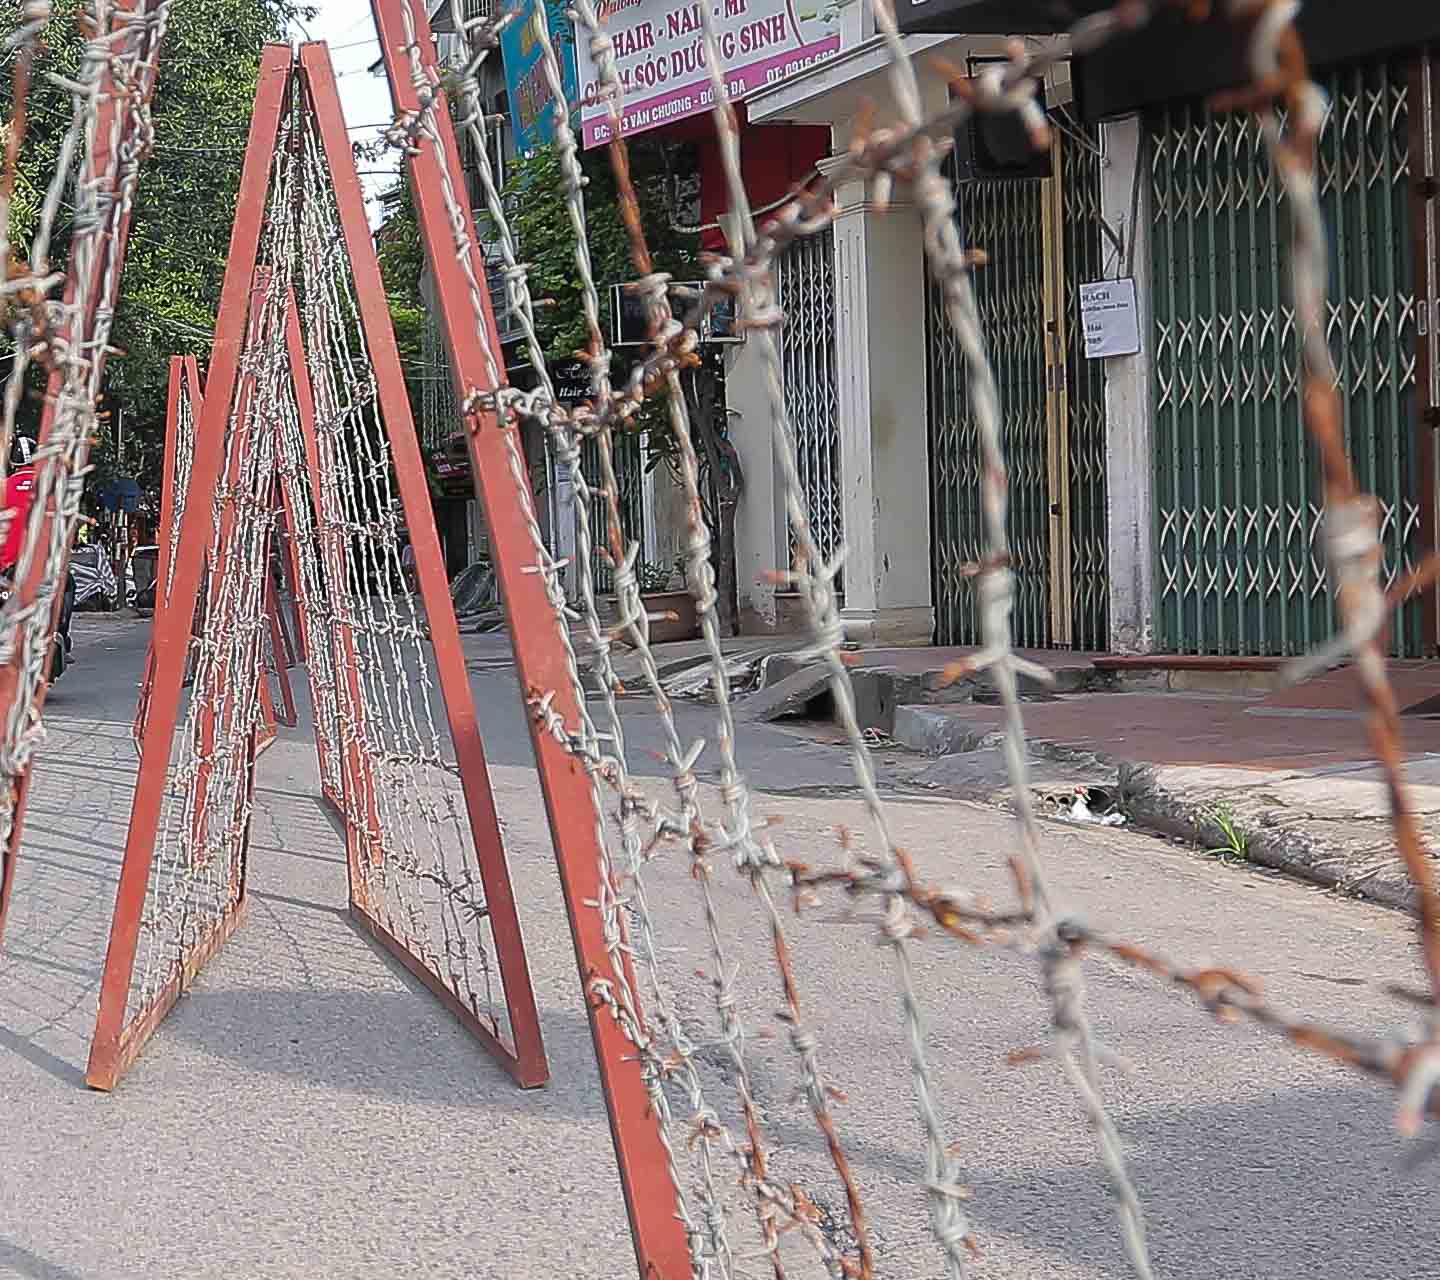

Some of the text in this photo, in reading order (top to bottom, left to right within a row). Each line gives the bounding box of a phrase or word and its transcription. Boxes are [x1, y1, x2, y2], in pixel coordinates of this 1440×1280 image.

[612, 21, 655, 59] HAIR
[667, 2, 705, 40] NAI
[634, 53, 668, 87] SÓC
[739, 14, 787, 54] SINH
